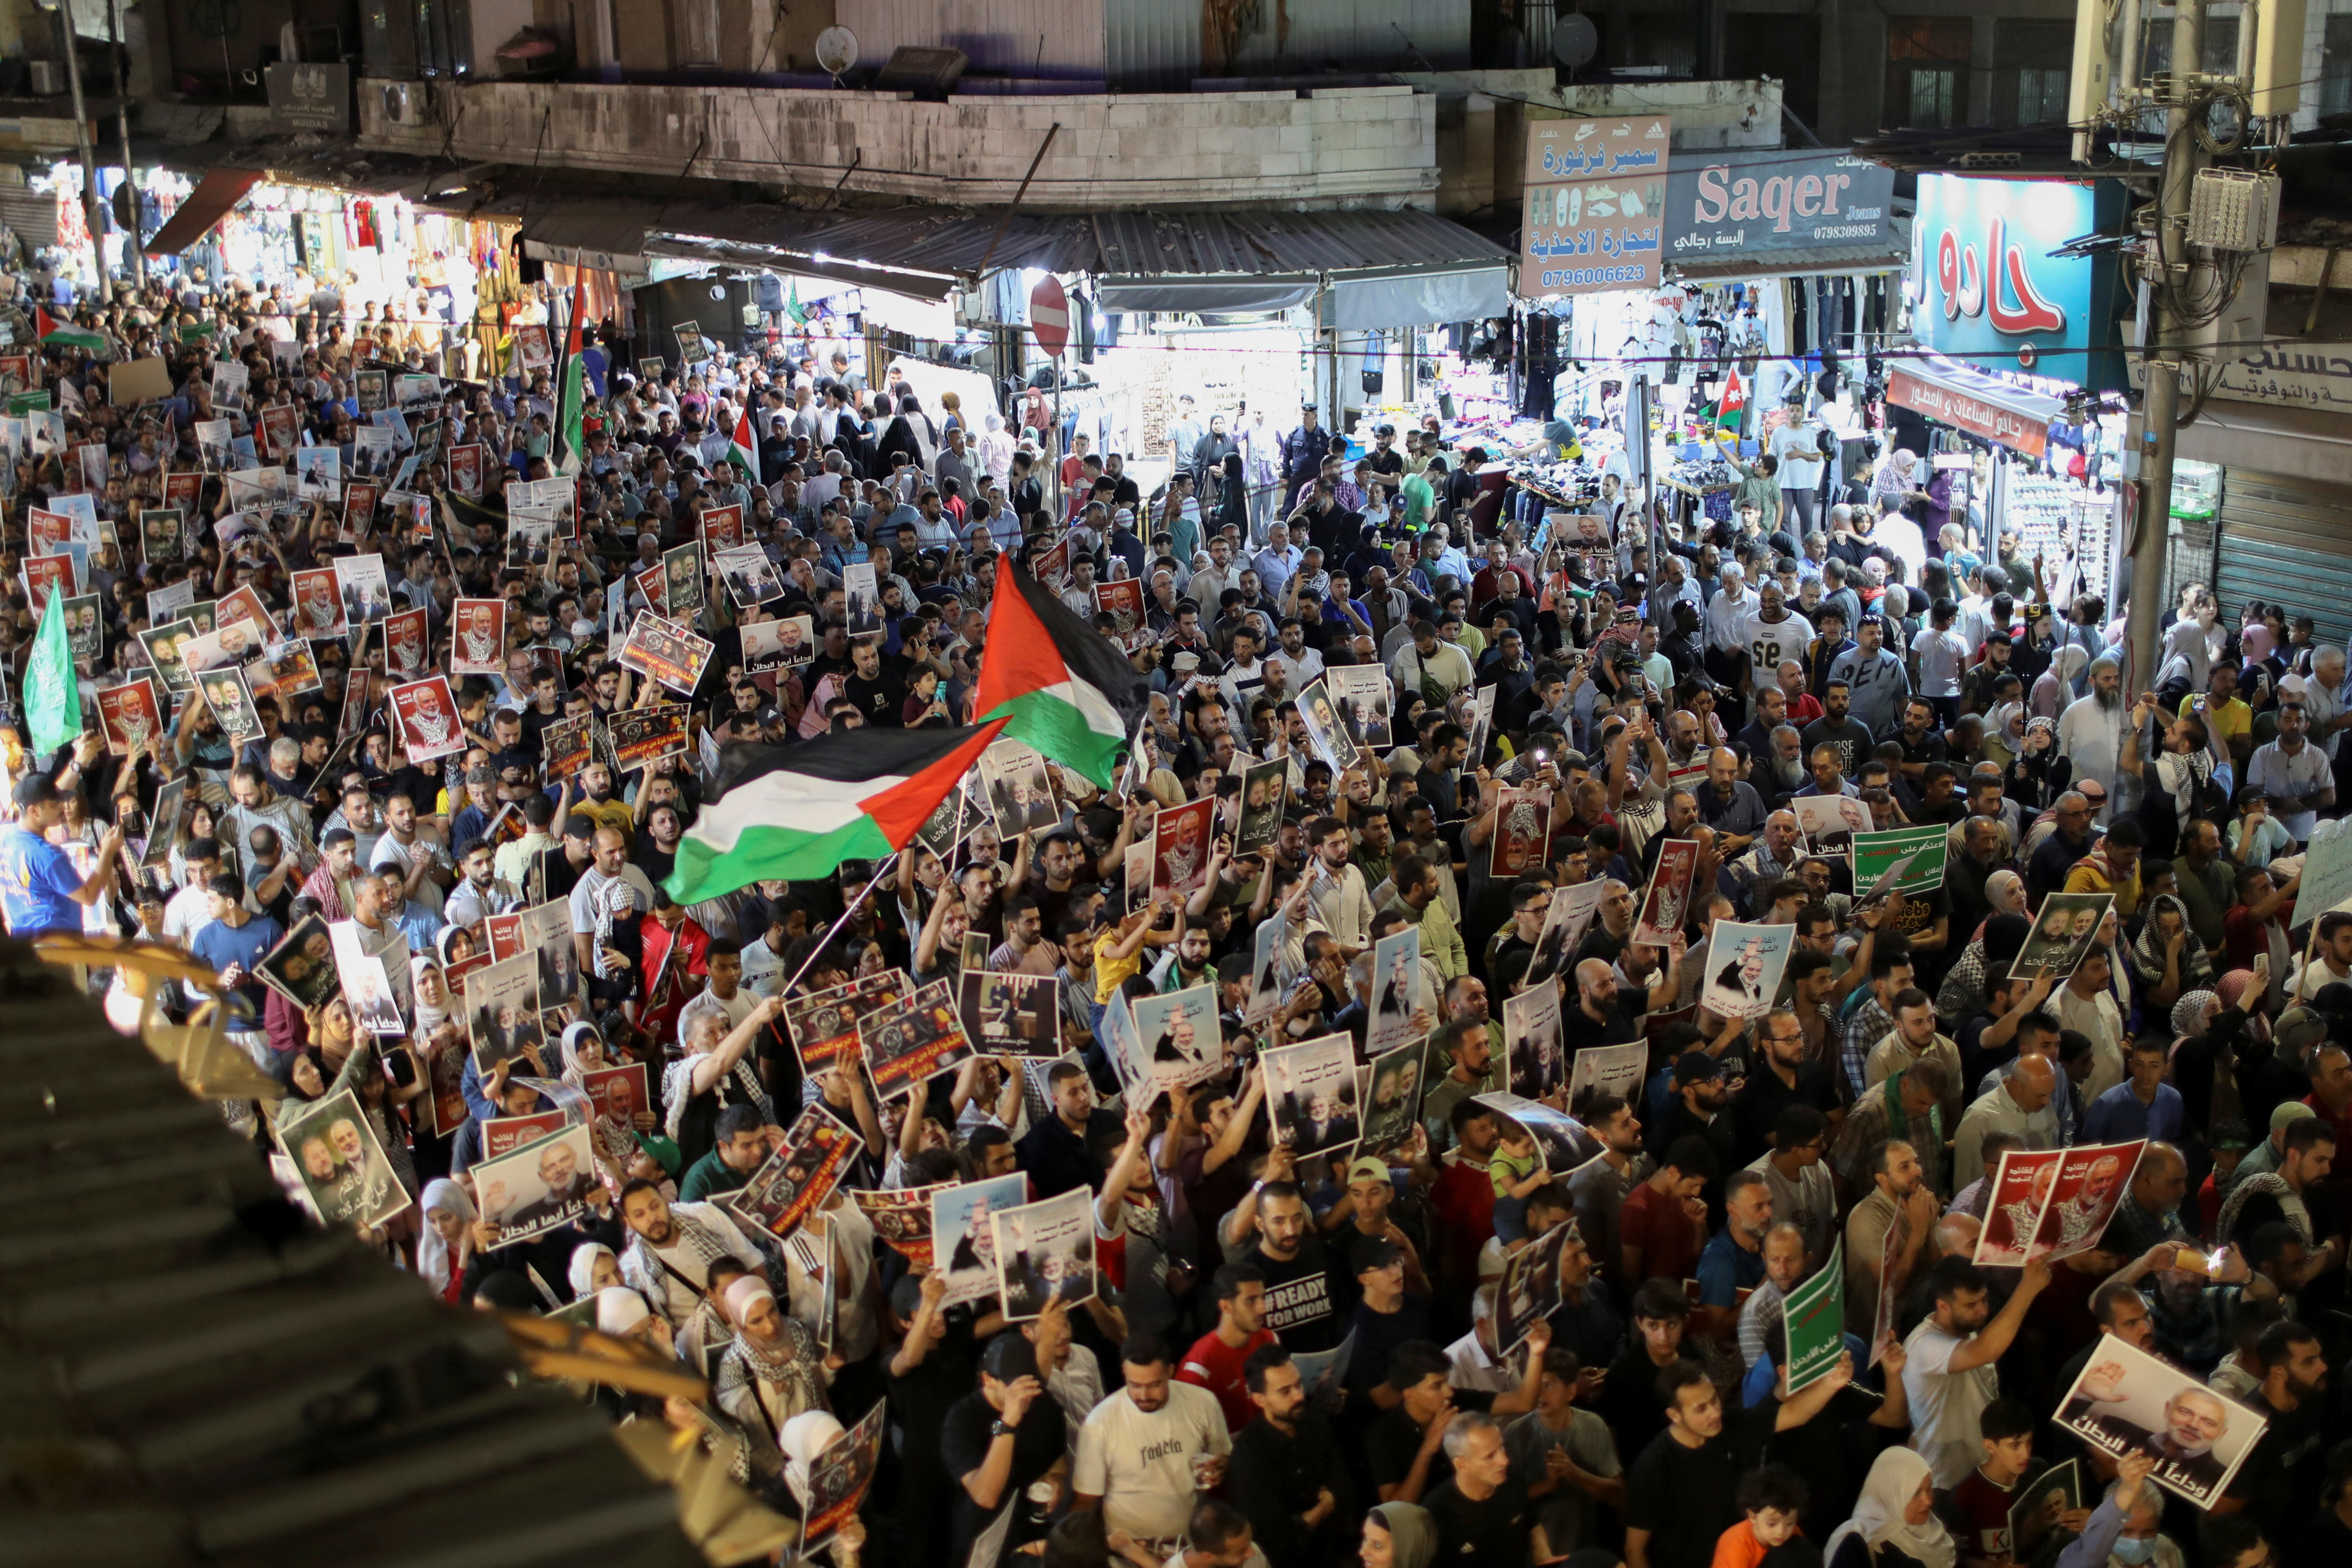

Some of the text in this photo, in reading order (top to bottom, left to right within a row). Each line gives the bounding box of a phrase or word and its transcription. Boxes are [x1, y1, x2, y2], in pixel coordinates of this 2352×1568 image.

[1543, 142, 1658, 177] سمير فرفورة
[1694, 164, 1850, 233] Saqer
[1845, 205, 1881, 221] Jeans
[1814, 223, 1877, 241] 0798309895
[1601, 225, 1660, 259] لتجارة
[1673, 229, 1744, 251] البسة رجالي
[1541, 265, 1645, 287] 0796006623
[1938, 210, 2066, 369] جادو
[625, 646, 648, 659] التجويع
[646, 656, 659, 664] حرب
[794, 654, 812, 663] وداعاً
[777, 657, 792, 667] أيها
[618, 748, 636, 760] التجويع
[1002, 758, 1017, 766] نداء
[1004, 760, 1034, 773] القائد الشهيد
[1901, 845, 1917, 854] على
[1902, 865, 1942, 880] إعلان حرب
[494, 926, 512, 935] القائد
[362, 1016, 401, 1029] وداعاً أيها
[2065, 1163, 2089, 1171] القائد
[1264, 1277, 1327, 1312] #READY
[1265, 1297, 1332, 1328] FOR WORK
[2164, 1462, 2208, 1498] وداعاً
